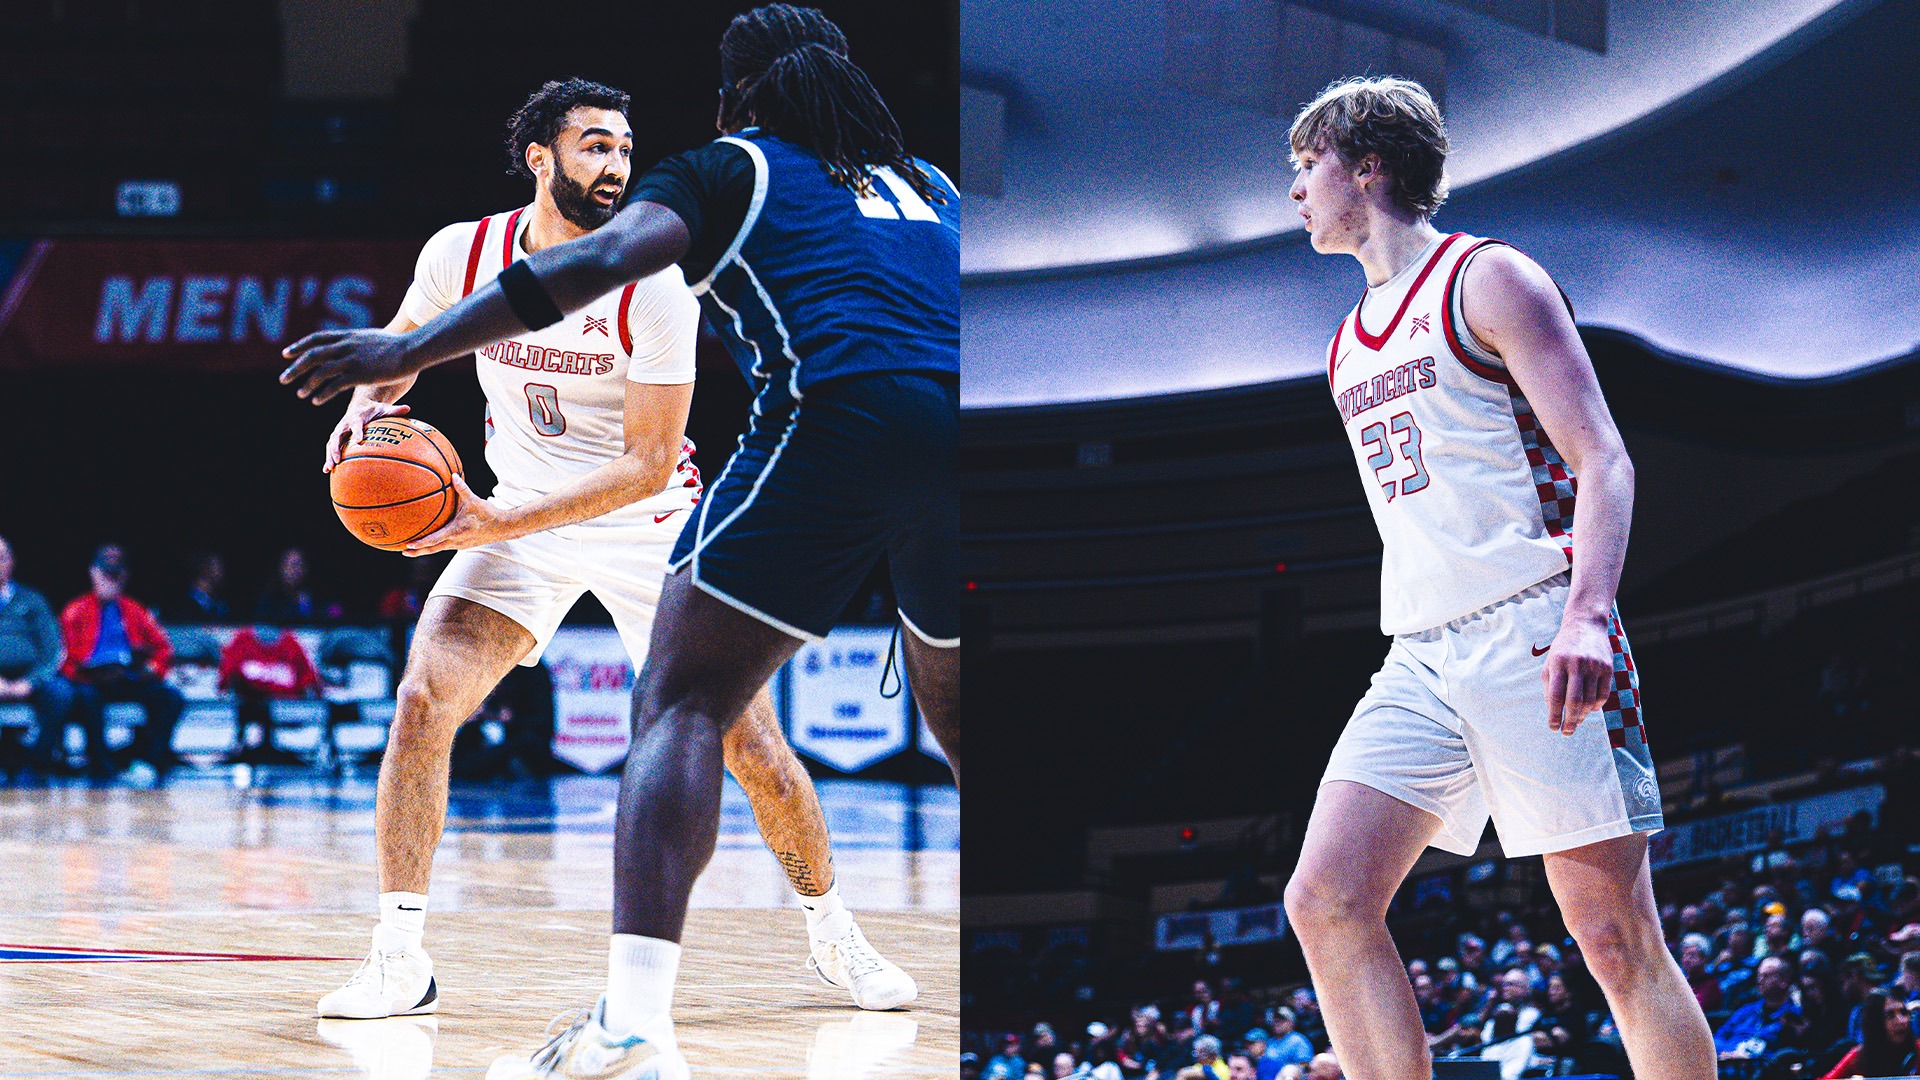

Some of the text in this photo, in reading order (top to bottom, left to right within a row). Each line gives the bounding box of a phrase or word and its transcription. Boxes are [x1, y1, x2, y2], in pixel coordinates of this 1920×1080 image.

[94, 275, 375, 343] MEN'S
[524, 382, 567, 437] 0
[1336, 355, 1437, 426] WILDCATS
[362, 426, 413, 440] GACY
[1361, 410, 1431, 504] 23
